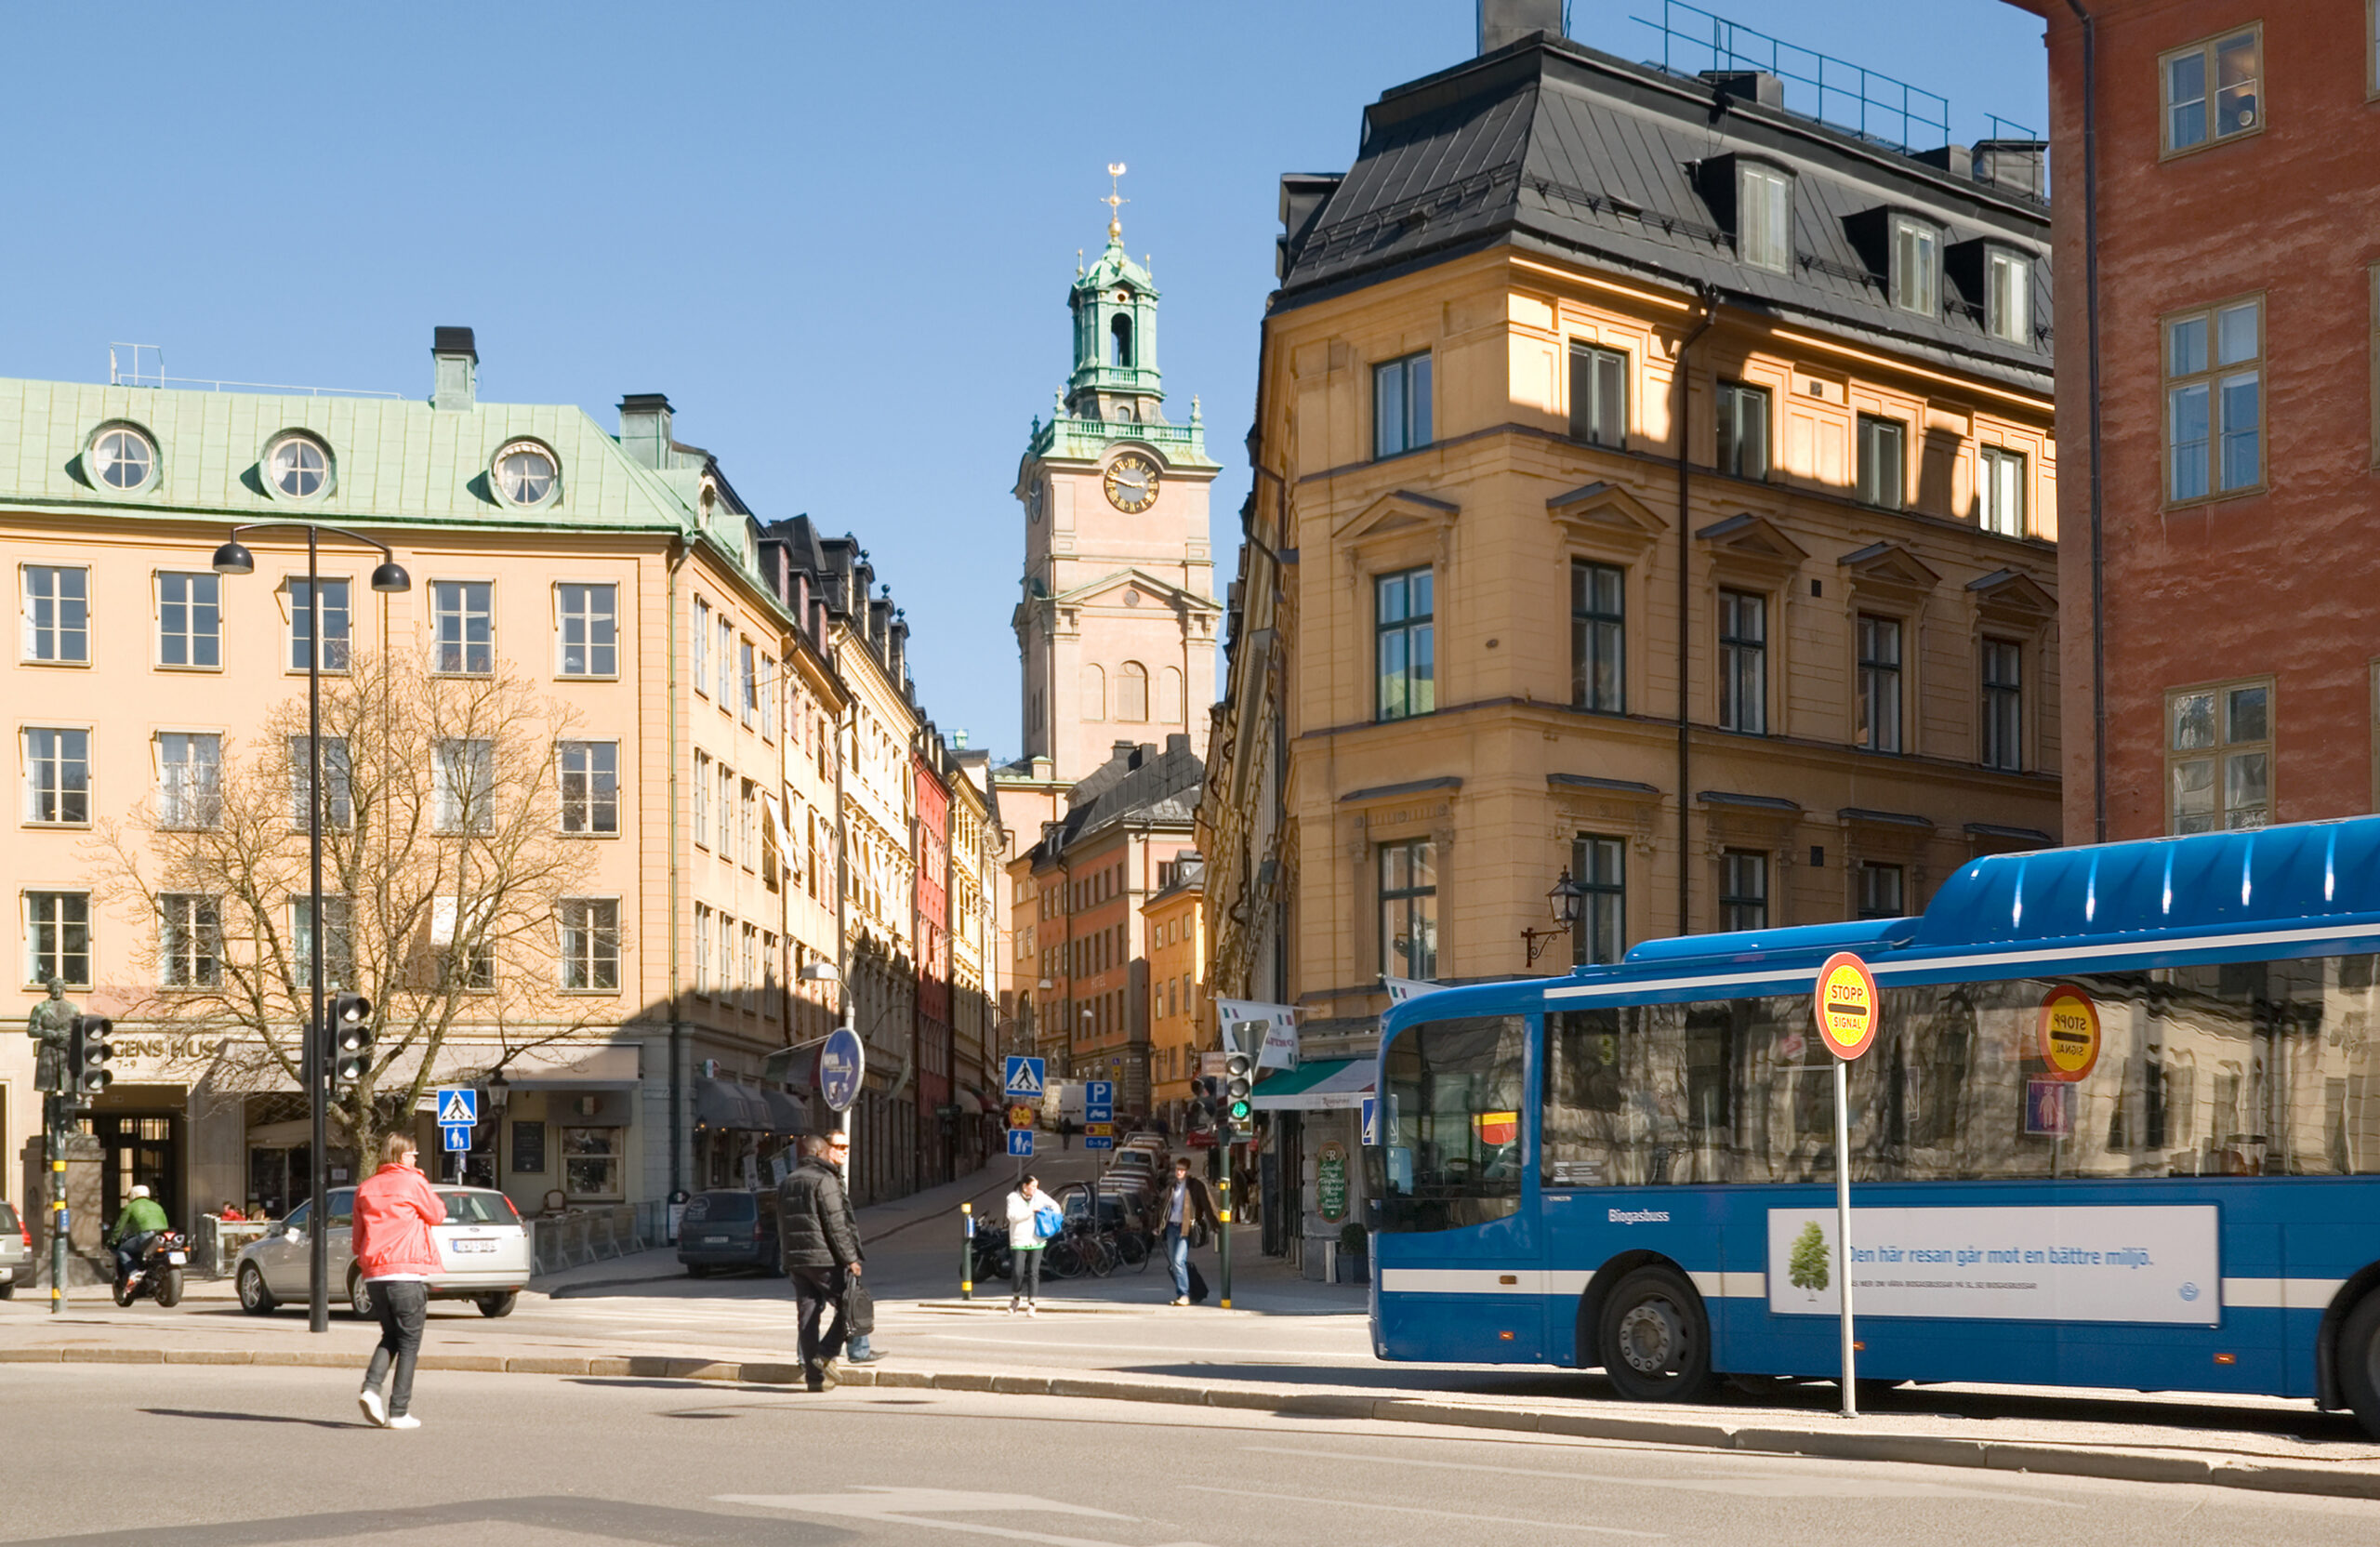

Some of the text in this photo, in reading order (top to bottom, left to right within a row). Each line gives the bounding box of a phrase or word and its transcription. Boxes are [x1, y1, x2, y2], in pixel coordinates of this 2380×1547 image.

[1831, 985, 1864, 1001] STOPP
[1833, 1016, 1861, 1029] SIGNAL
[170, 1039, 217, 1058] HUS
[116, 1060, 137, 1069] 7-9
[1093, 1083, 1106, 1103] P
[1607, 1208, 1671, 1225] Biogasbuss
[1879, 1245, 1905, 1263] här
[1910, 1250, 1953, 1263] resan
[1956, 1245, 1983, 1267] går
[1988, 1247, 2020, 1264] mot
[2024, 1250, 2045, 1264] en
[2048, 1246, 2102, 1265] bättre
